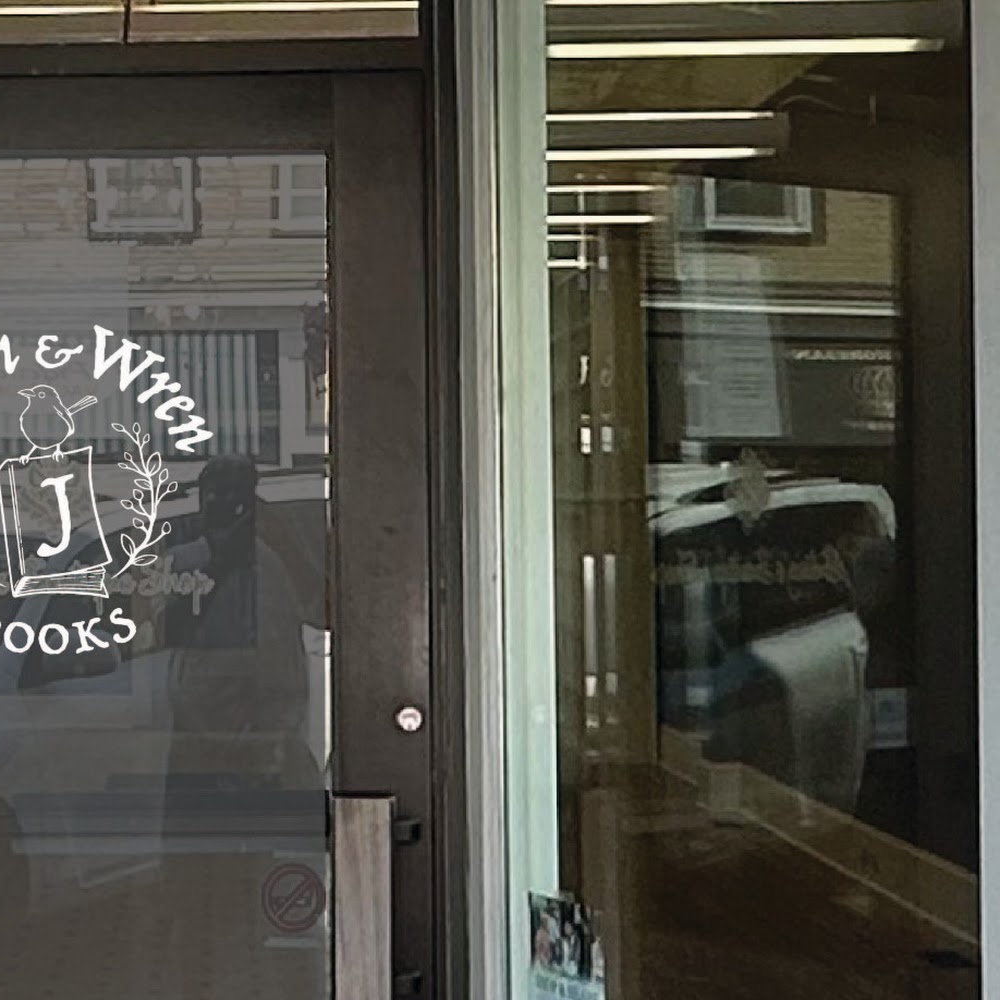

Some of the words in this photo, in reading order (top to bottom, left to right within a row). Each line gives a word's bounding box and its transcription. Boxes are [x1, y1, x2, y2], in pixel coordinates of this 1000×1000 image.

[35, 335, 83, 369] &
[93, 324, 214, 453] Wren
[36, 474, 74, 557] J
